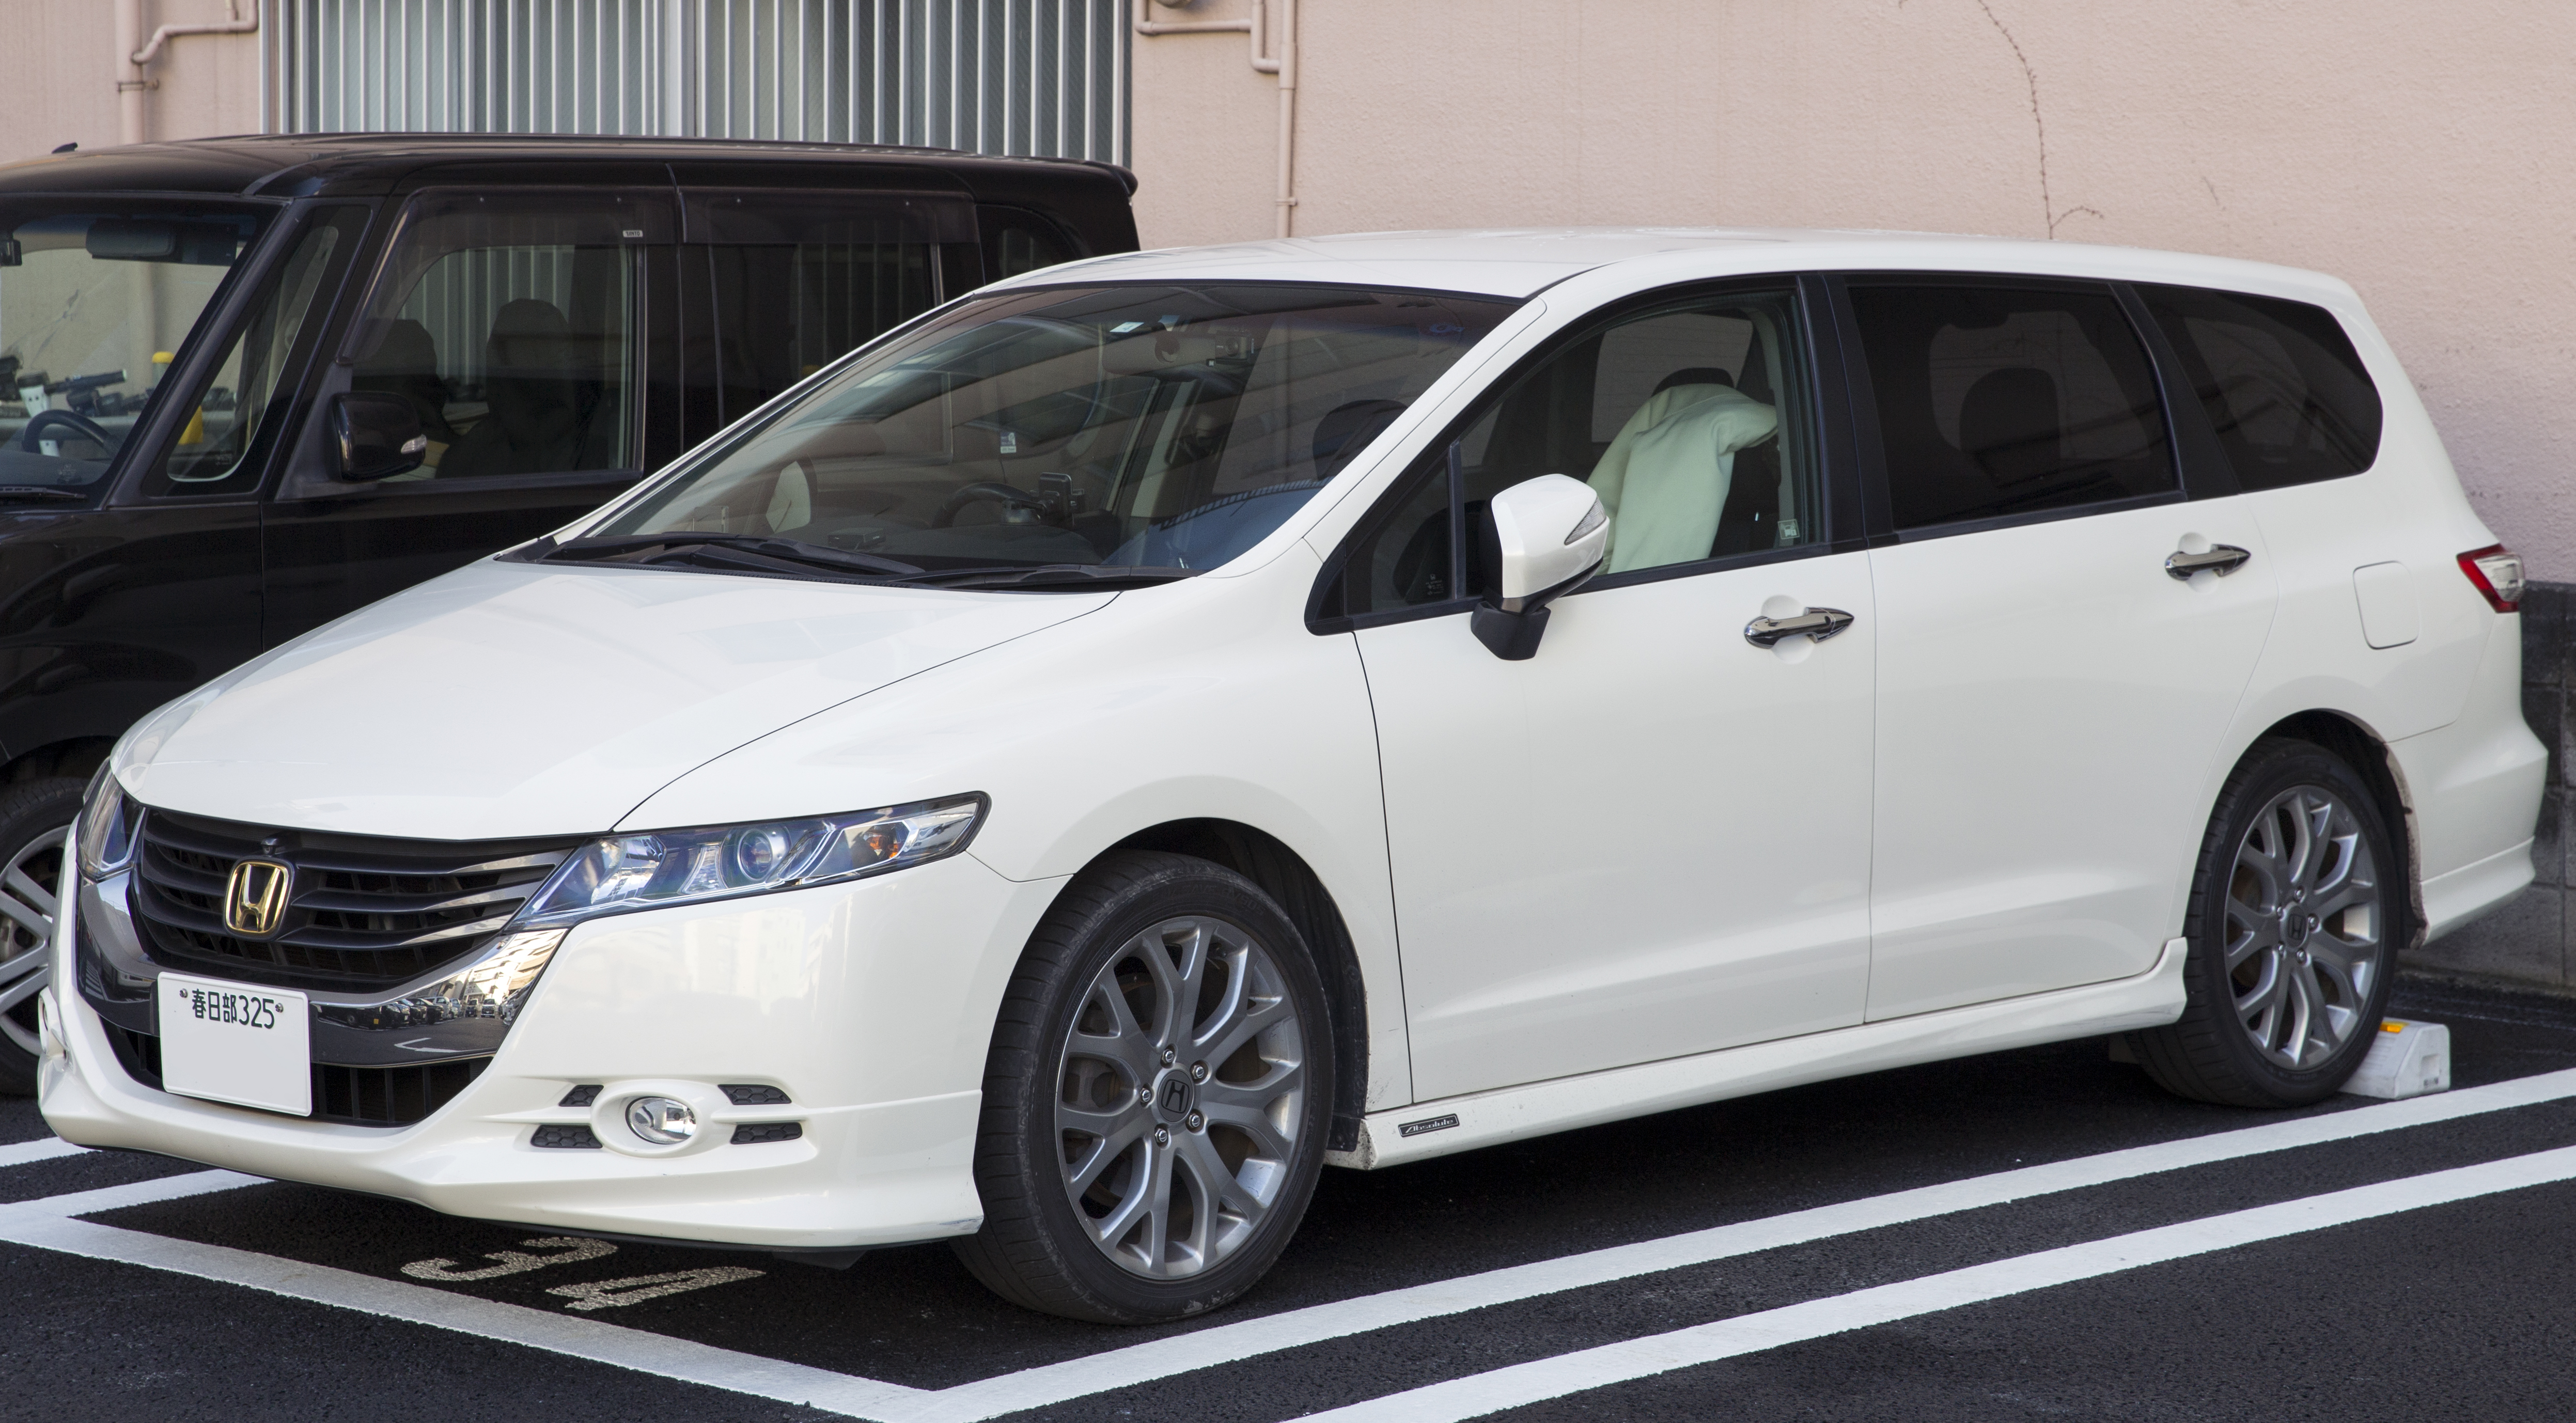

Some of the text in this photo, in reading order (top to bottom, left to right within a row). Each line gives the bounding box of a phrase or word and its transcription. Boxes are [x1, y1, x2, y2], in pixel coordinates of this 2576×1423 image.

[192, 988, 275, 1029] 春日部325
[1405, 1119, 1454, 1133] Absolute
